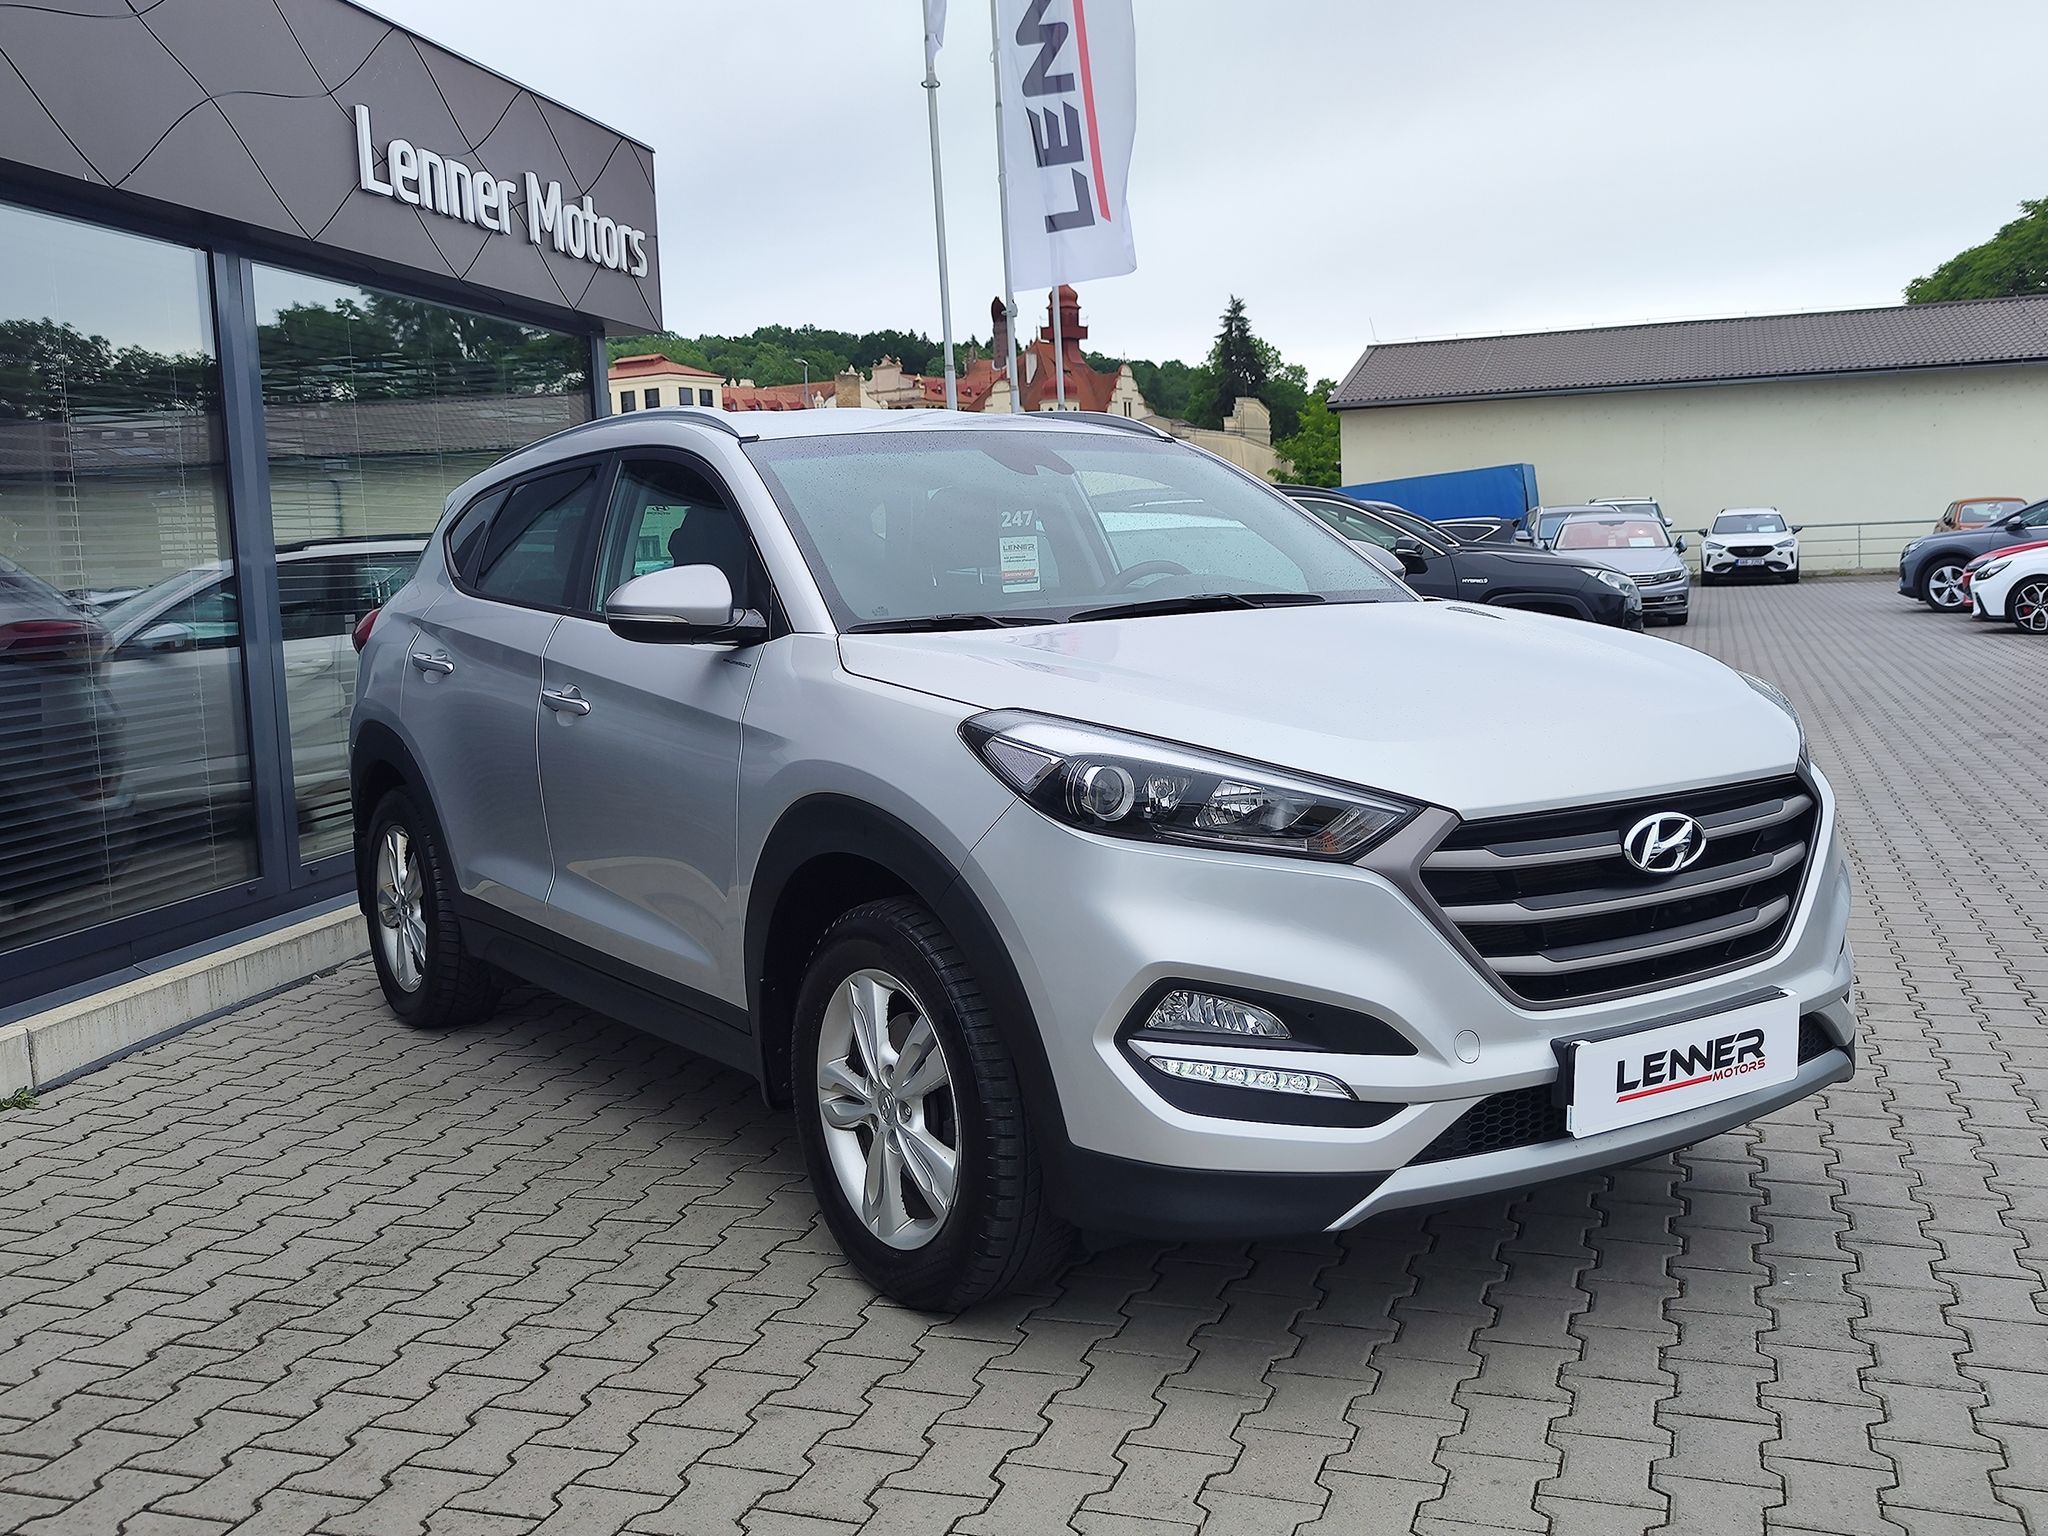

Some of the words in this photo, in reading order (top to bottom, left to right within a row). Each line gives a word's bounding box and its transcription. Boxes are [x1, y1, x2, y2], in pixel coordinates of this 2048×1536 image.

[354, 104, 516, 236] Lenner
[525, 171, 649, 278] Motors
[1001, 510, 1033, 528] 247
[1003, 543, 1035, 551] LENNER
[1616, 1028, 1765, 1093] LENNER
[1712, 1059, 1766, 1082] MOTORS
